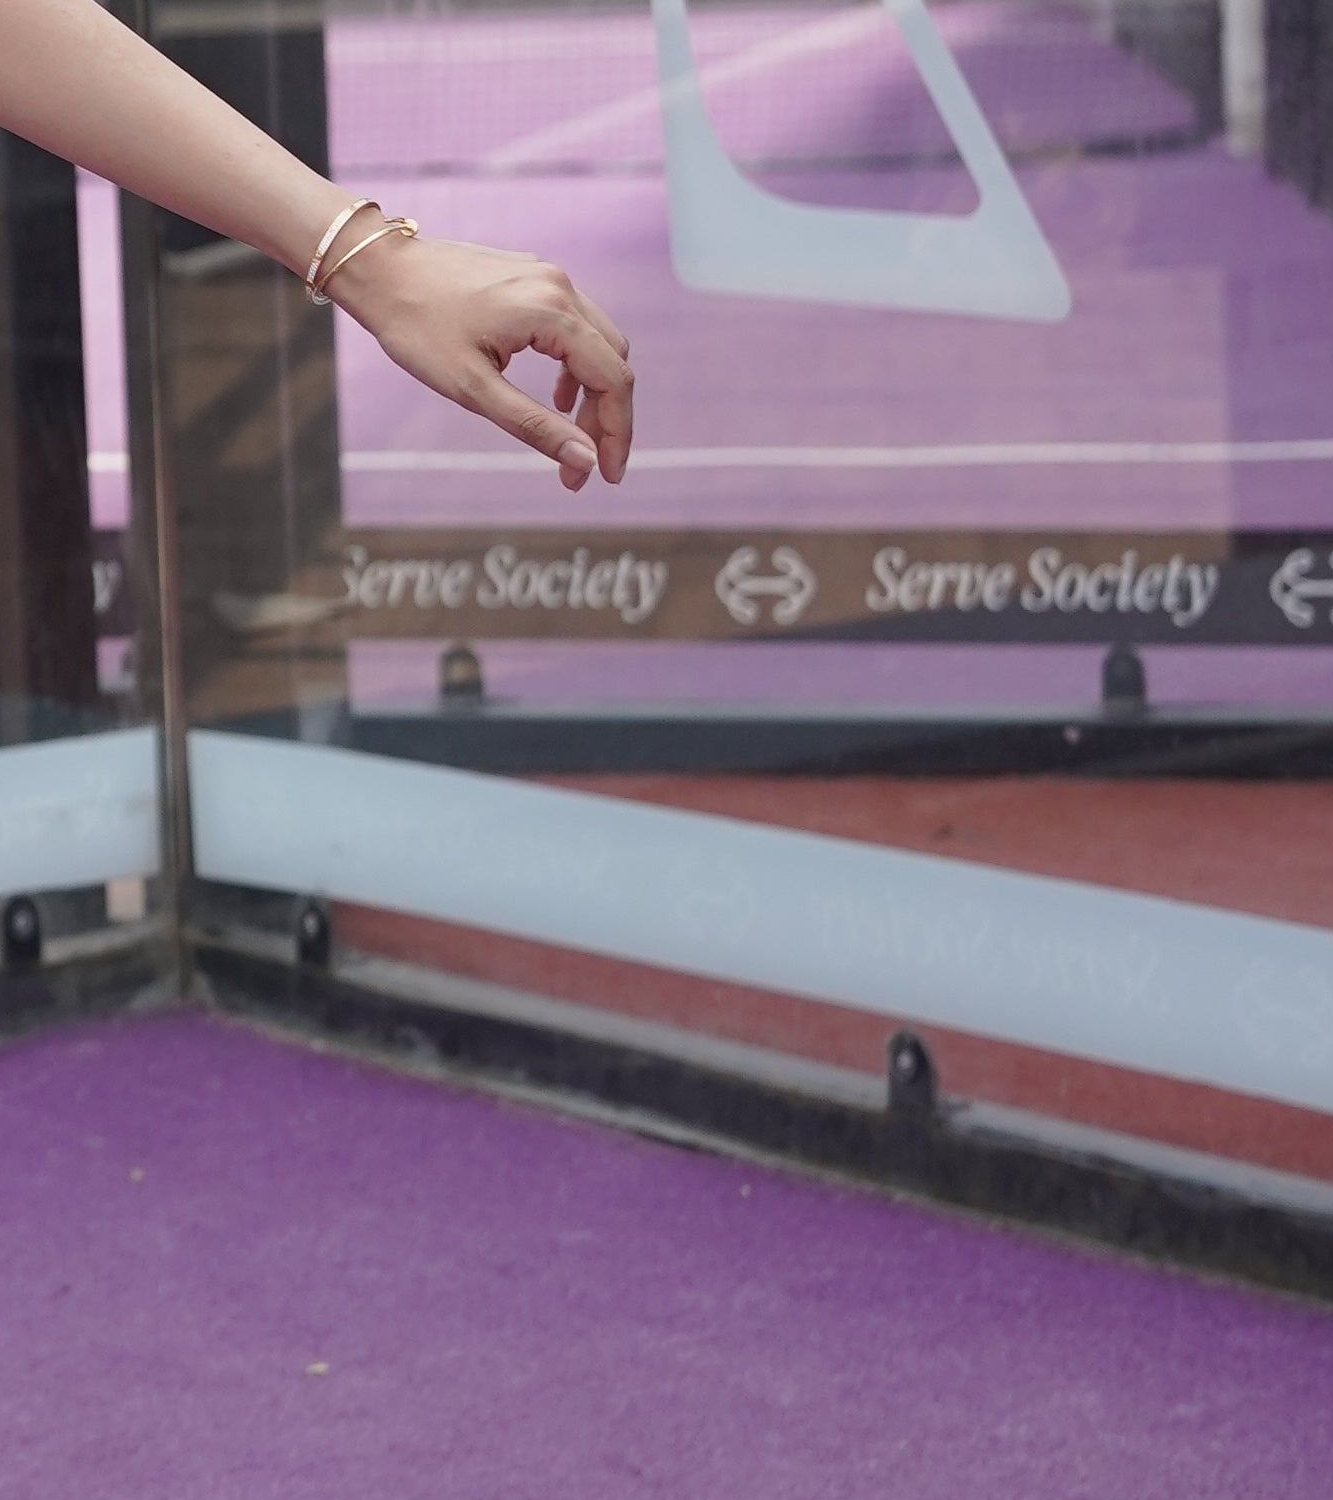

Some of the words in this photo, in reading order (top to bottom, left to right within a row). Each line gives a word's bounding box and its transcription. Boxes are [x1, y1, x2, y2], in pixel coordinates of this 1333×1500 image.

[343, 544, 475, 610] Serve
[475, 545, 667, 624] Society
[864, 546, 1023, 615] Serve
[1019, 547, 1218, 629] Society
